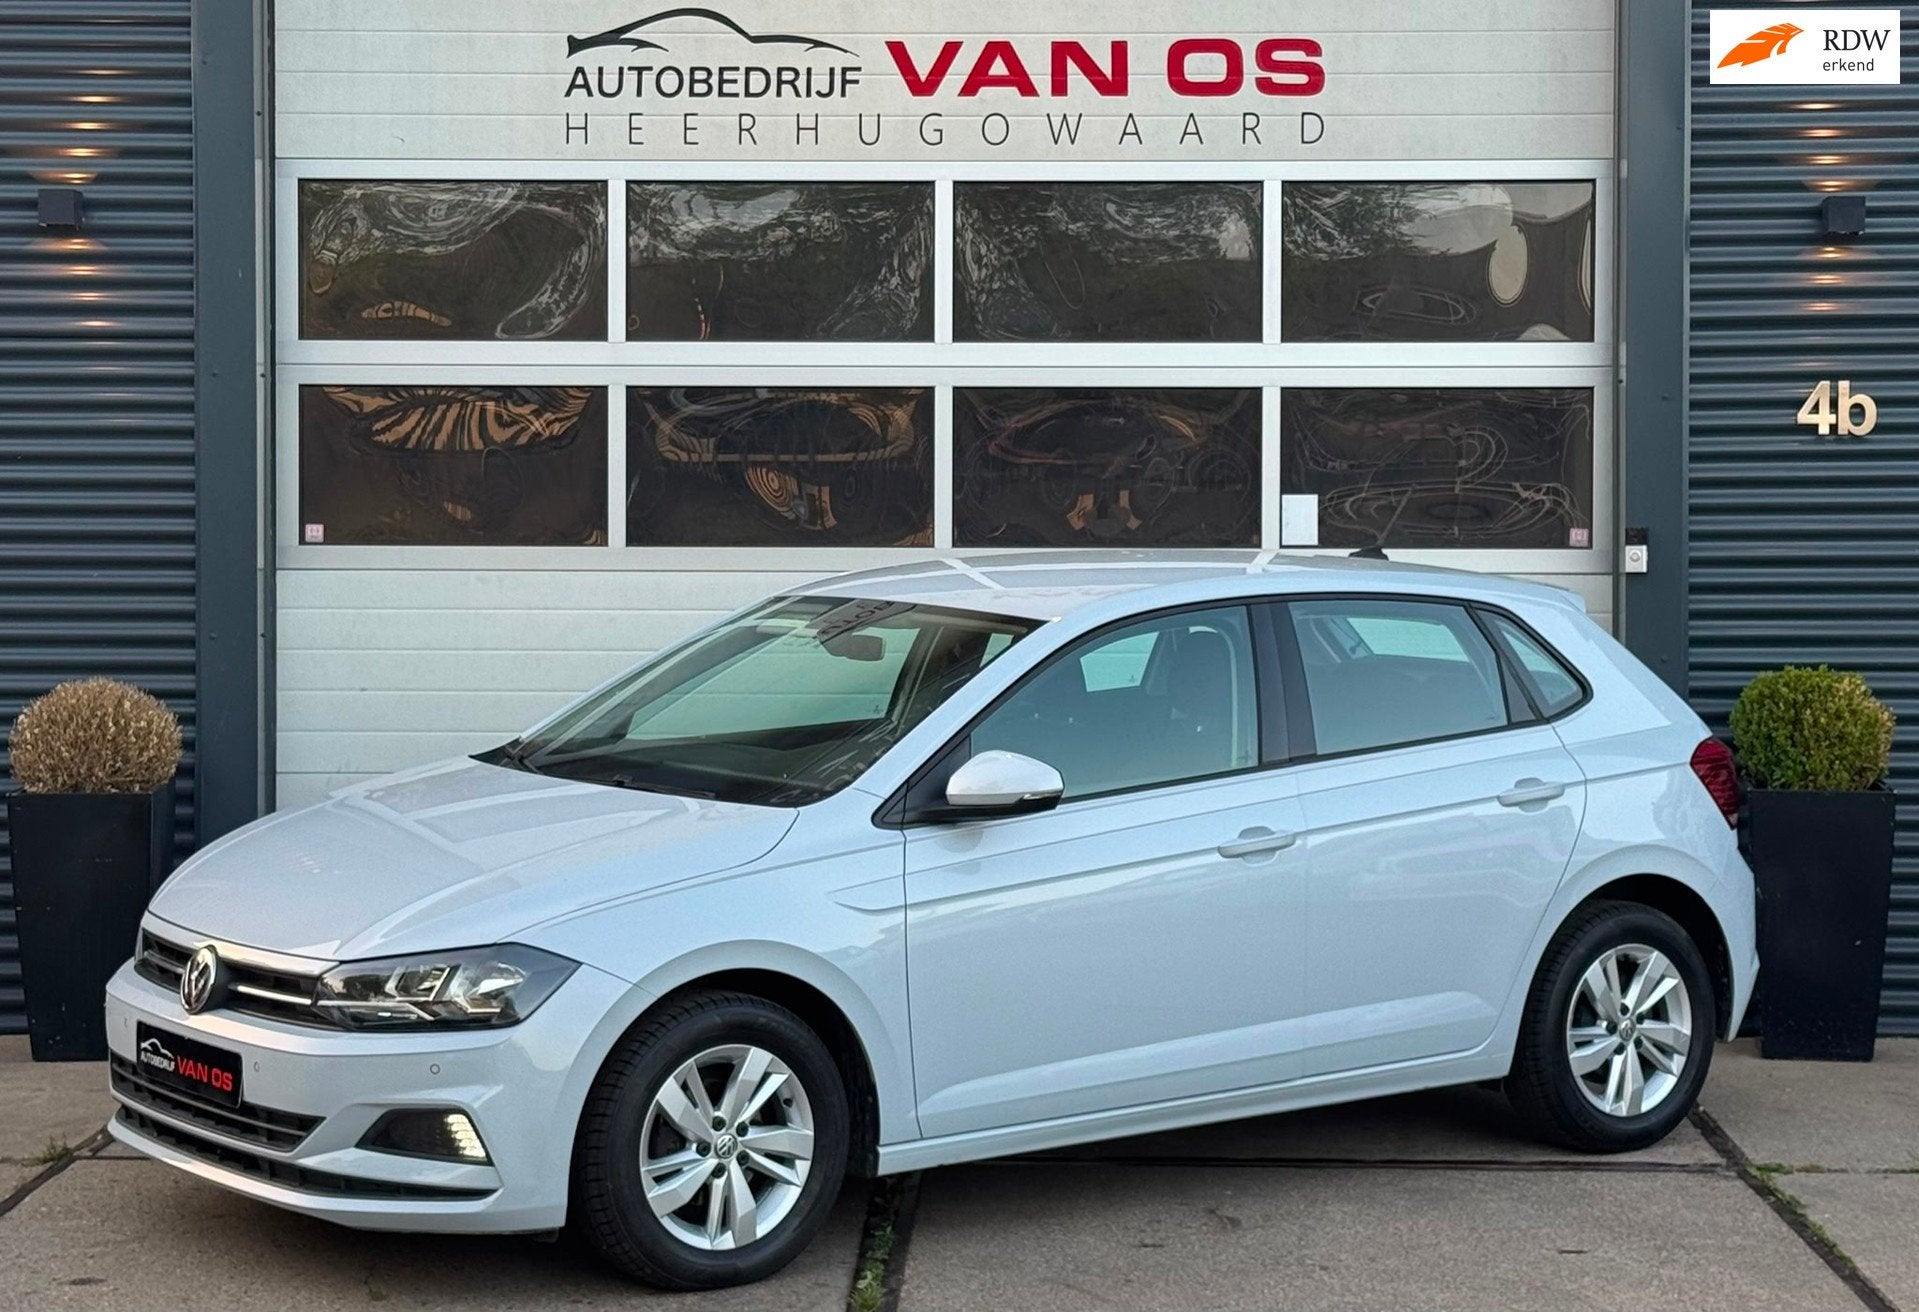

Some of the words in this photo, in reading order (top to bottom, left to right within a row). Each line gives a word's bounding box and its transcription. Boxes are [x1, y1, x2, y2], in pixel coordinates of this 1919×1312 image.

[564, 65, 862, 99] AUTOBEDRIJF
[886, 39, 1129, 98] VAN
[1166, 37, 1326, 97] OS
[566, 112, 1325, 146] HEERHUGOWAARD
[1797, 380, 1877, 436] 4b
[177, 1055, 208, 1083] VAN
[211, 1066, 233, 1092] OS
